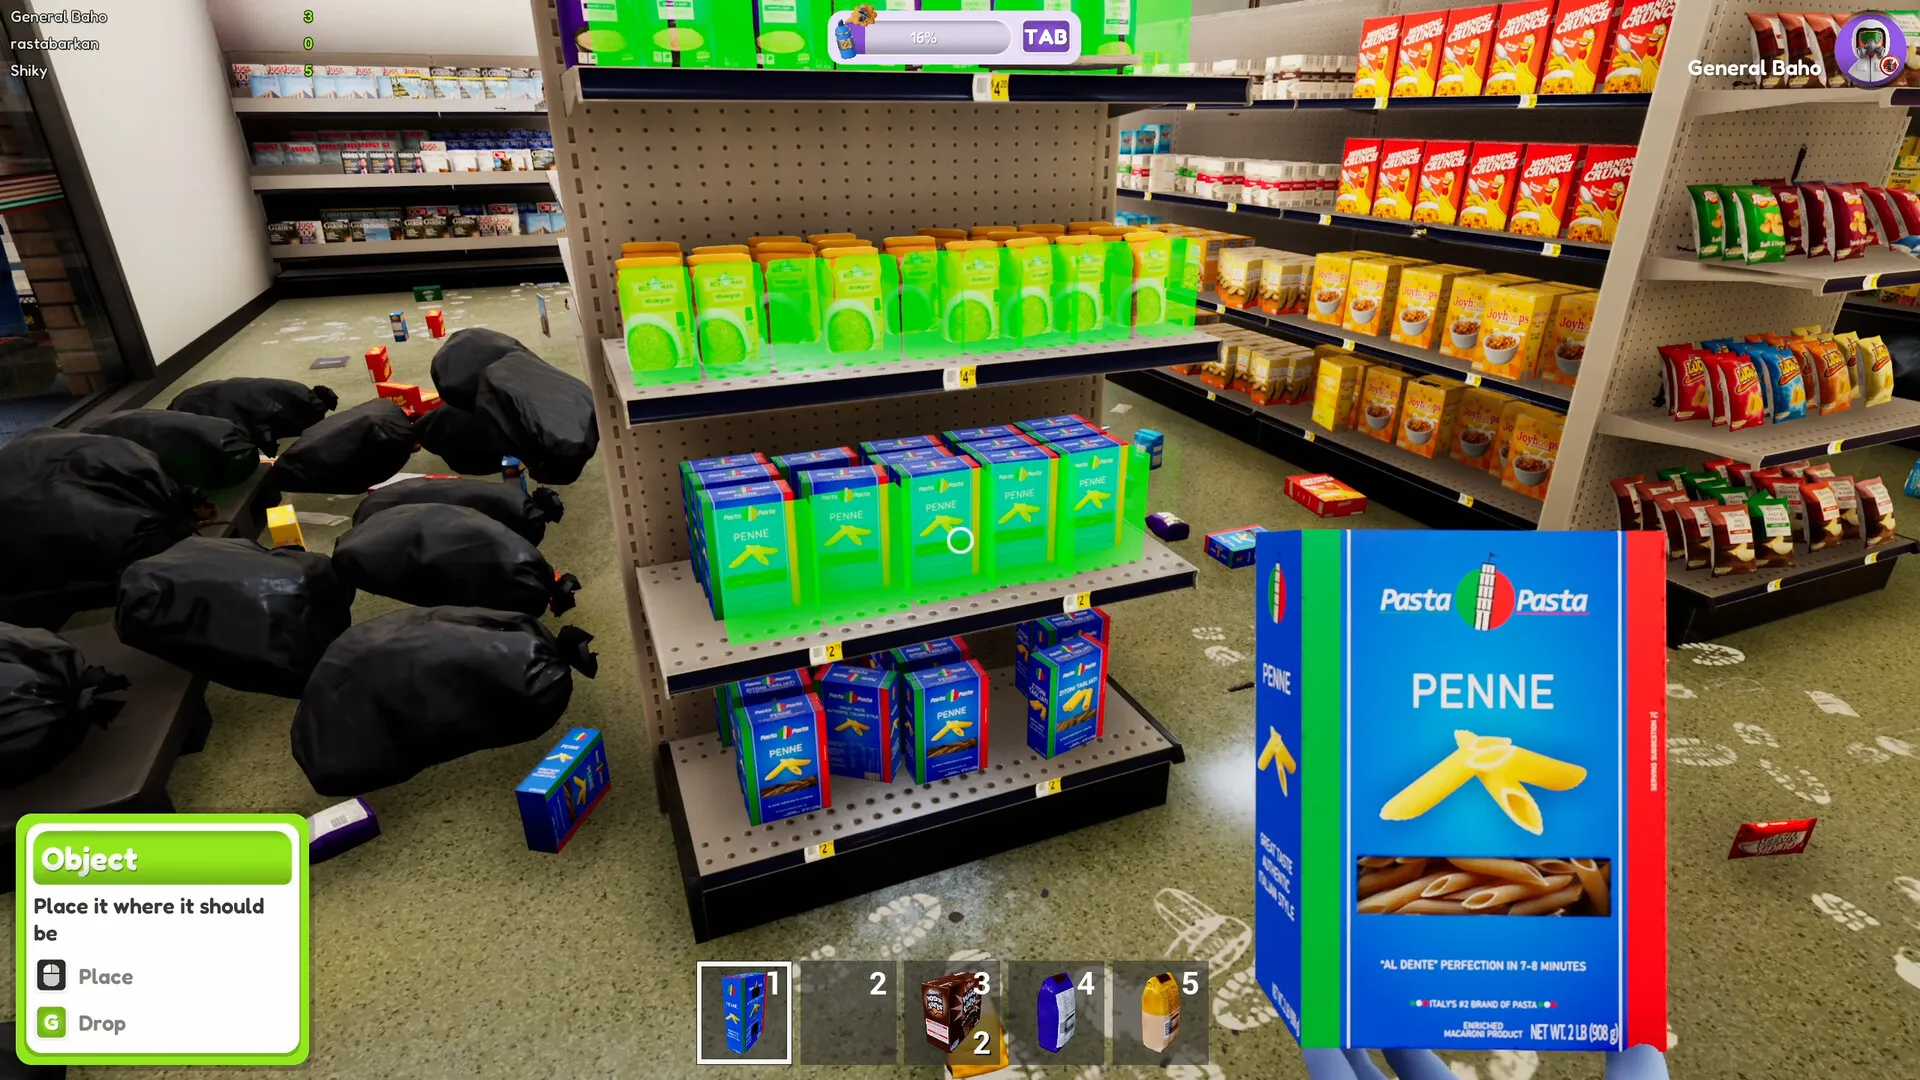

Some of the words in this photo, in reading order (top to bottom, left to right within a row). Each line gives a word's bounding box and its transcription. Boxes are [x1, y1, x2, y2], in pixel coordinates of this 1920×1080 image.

[1556, 8, 1612, 34] CRUNCH
[1622, 5, 1676, 30] CRUNC
[1448, 20, 1494, 43] CRUNCH
[1500, 14, 1551, 39] CRUNCH
[1362, 29, 1400, 50] CRUNCH
[1403, 24, 1445, 46] CRUNCH
[1344, 152, 1379, 167] CRUNCH
[1382, 154, 1421, 170] CRUNCH
[1424, 156, 1467, 172] CRUNCH
[1472, 158, 1519, 176] CRUNCH
[1524, 160, 1575, 178] CRUNCH
[1584, 166, 1634, 182] CRUNC
[1079, 476, 1106, 488] PENNE
[1004, 488, 1035, 500] PENNE
[926, 500, 956, 512] PENNE
[830, 510, 864, 521] PENNE
[733, 528, 770, 542] PENNE
[1380, 588, 1453, 612] Pasta
[1516, 589, 1589, 613] Pasta
[1076, 676, 1098, 690] TAGLIATI
[1262, 661, 1291, 696] PENNE
[930, 696, 946, 704] Pasta
[958, 690, 974, 698] Pasta
[1412, 672, 1555, 710] PENNE
[936, 706, 968, 720] PENNE
[768, 744, 803, 758] PENNE
[1440, 960, 1504, 971] PERFECTION
[1507, 960, 1518, 971] IN
[1520, 961, 1538, 971] 7-8
[1540, 961, 1587, 972] MINUTES
[1470, 1000, 1499, 1009] BRAND
[1500, 1000, 1511, 1009] OF
[1512, 1000, 1538, 1010] PASTA
[1463, 1021, 1504, 1030] ENRICHED
[1444, 1029, 1485, 1038] MACARONI
[1486, 1029, 1523, 1039] PRODUCT
[1530, 1023, 1547, 1040] NET
[1549, 1024, 1566, 1041] WT.
[1568, 1024, 1574, 1041] 2
[1575, 1024, 1587, 1042] LB
[1588, 1024, 1608, 1043] (908
[1609, 1025, 1619, 1045] g)
